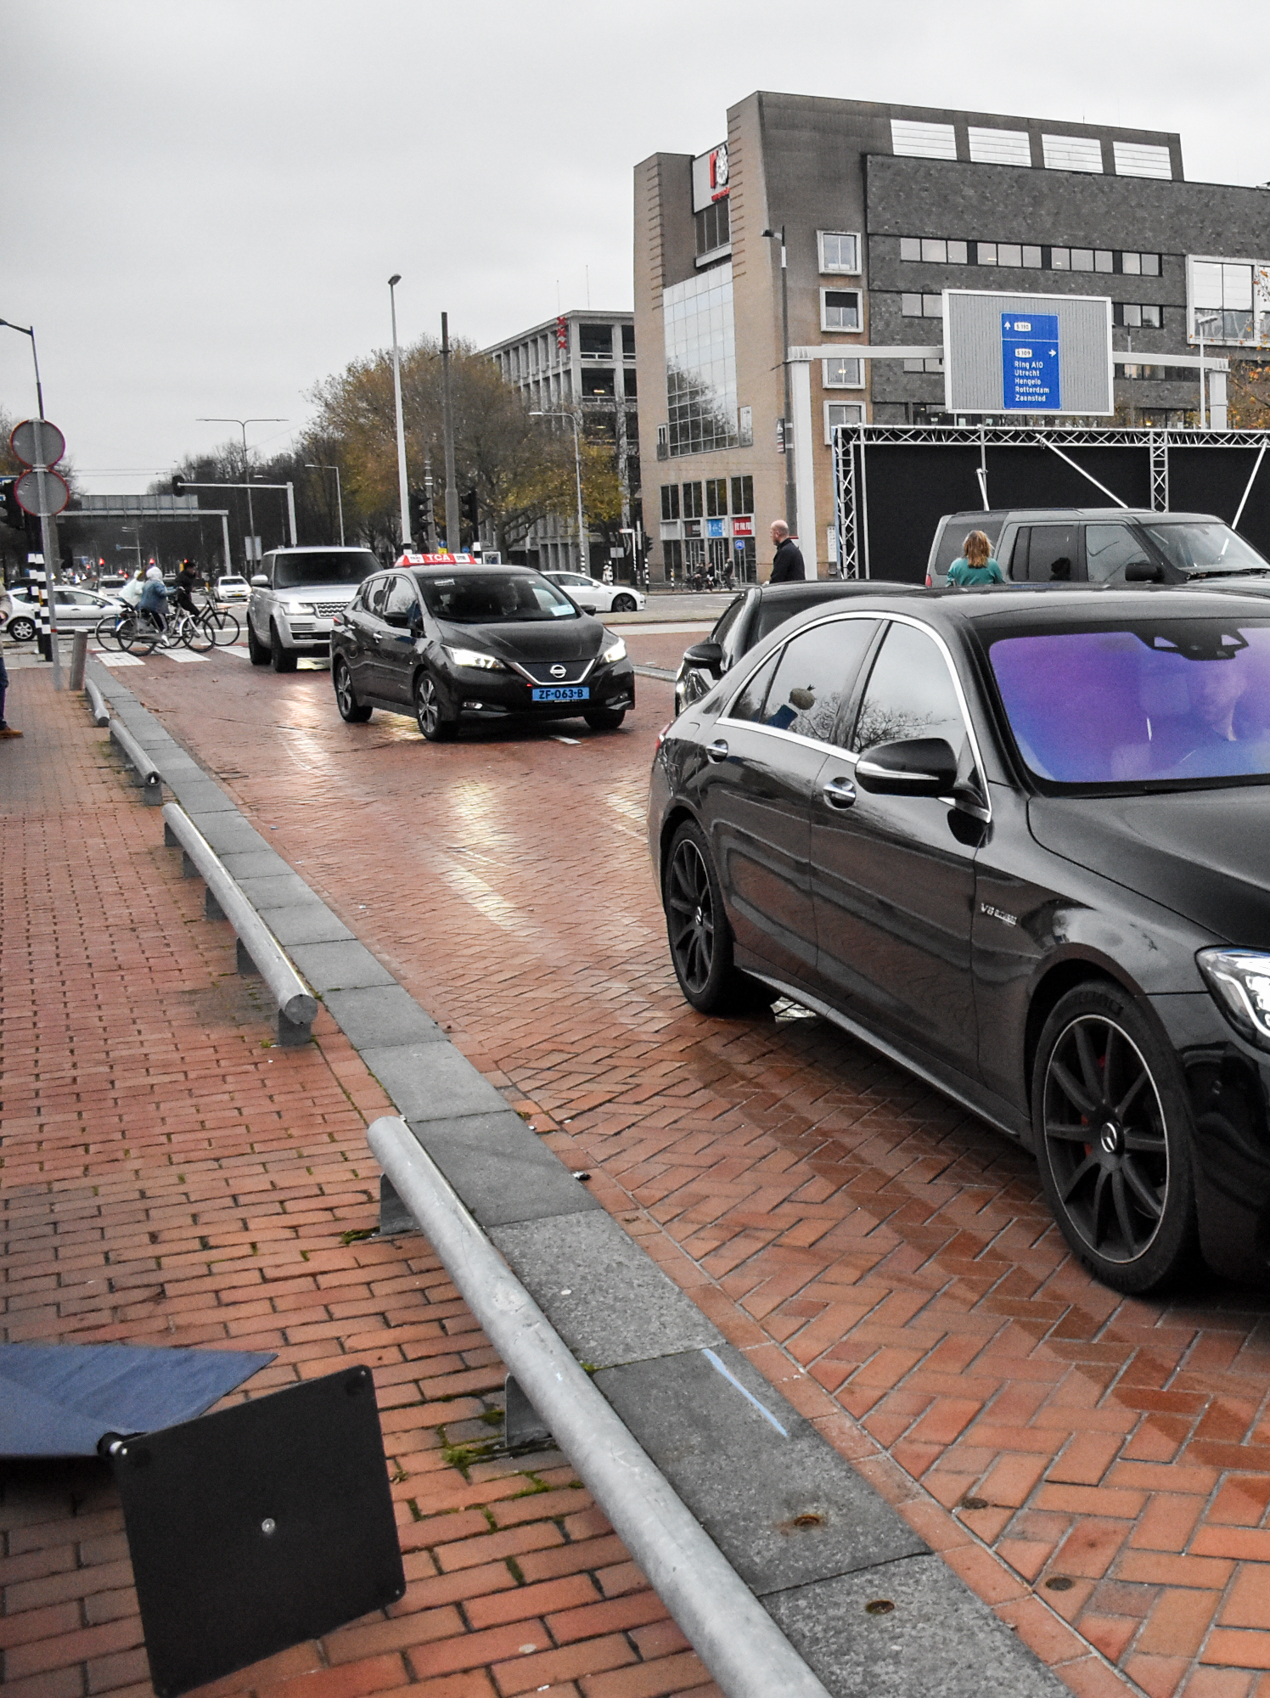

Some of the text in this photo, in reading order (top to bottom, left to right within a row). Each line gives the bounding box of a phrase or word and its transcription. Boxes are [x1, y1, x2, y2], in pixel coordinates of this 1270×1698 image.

[1014, 360, 1044, 370] Ring A10
[1014, 369, 1040, 377] Utrecht
[1014, 378, 1041, 387] Hengelo
[1015, 386, 1050, 394] Rotterdam
[1015, 394, 1046, 402] Zaanstad
[539, 689, 584, 699] ZF-063-B
